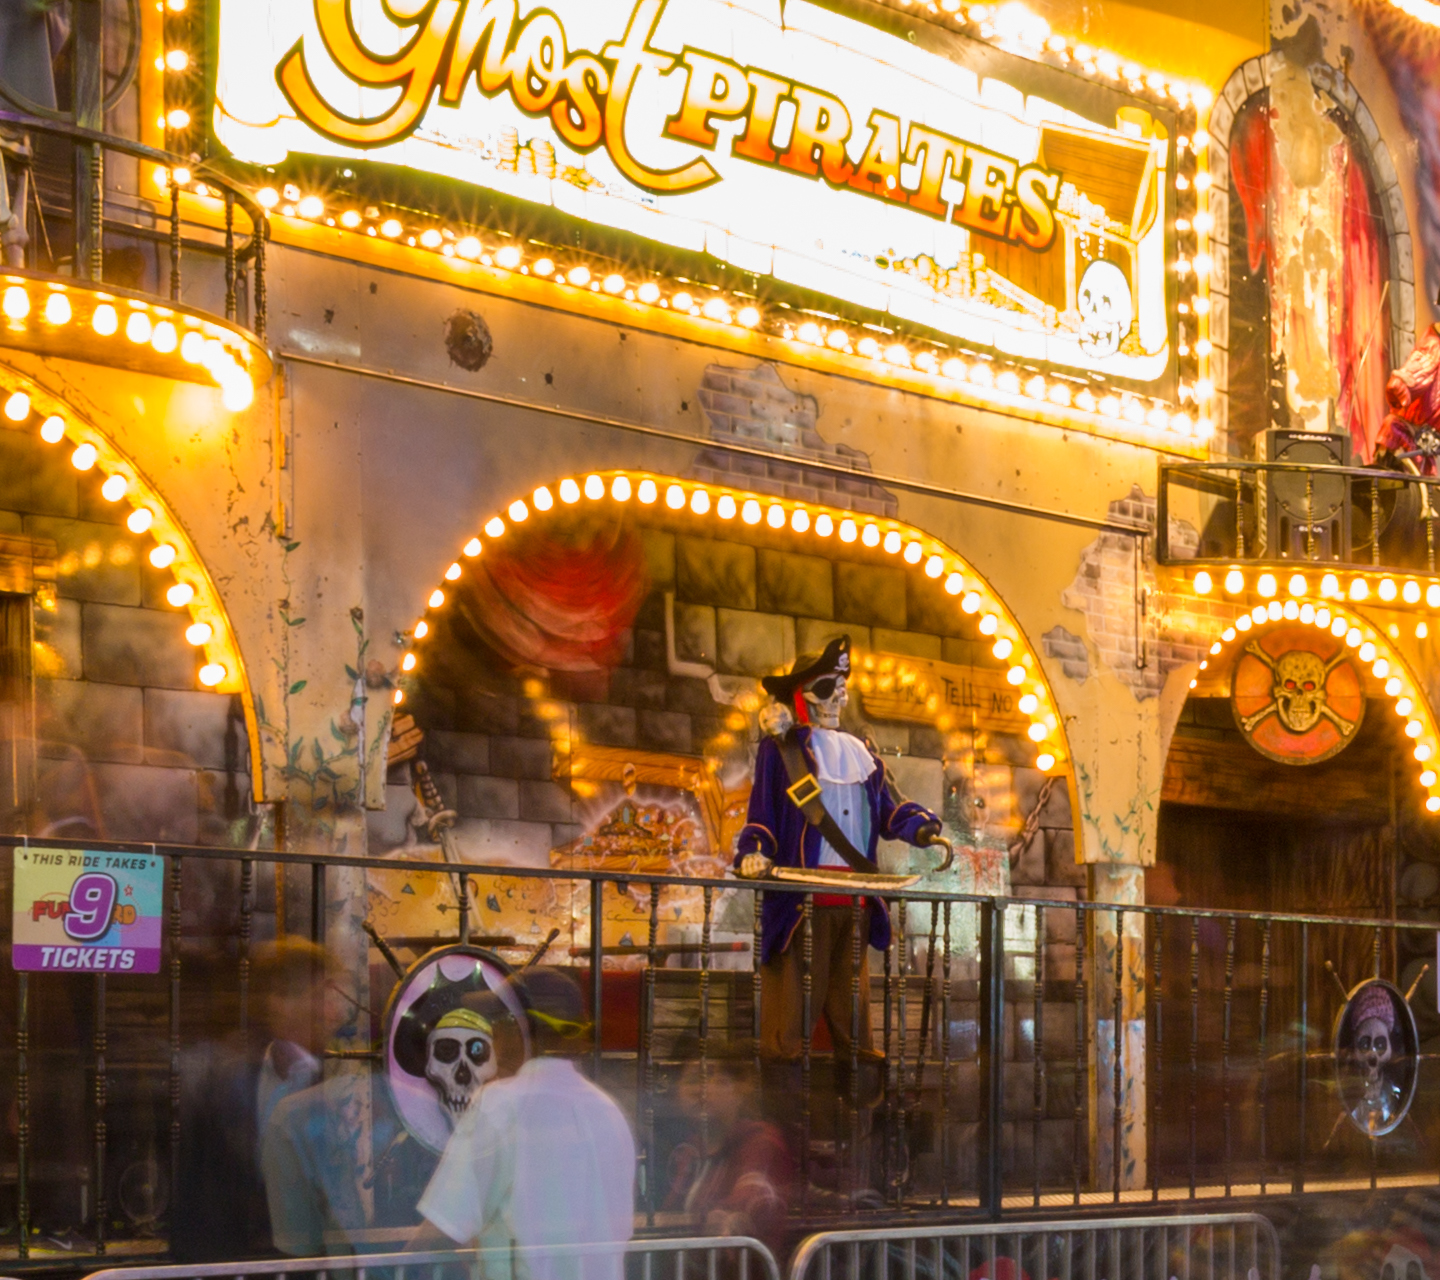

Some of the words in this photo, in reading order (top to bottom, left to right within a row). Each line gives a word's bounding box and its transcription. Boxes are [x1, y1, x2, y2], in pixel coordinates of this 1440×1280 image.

[661, 43, 1063, 253] PIRATES
[991, 692, 1013, 714] NO
[32, 853, 63, 866] THIS
[68, 855, 101, 868] RIDE
[105, 857, 148, 870] TAKES
[64, 871, 118, 942] 9
[41, 946, 136, 970] TICKETS
